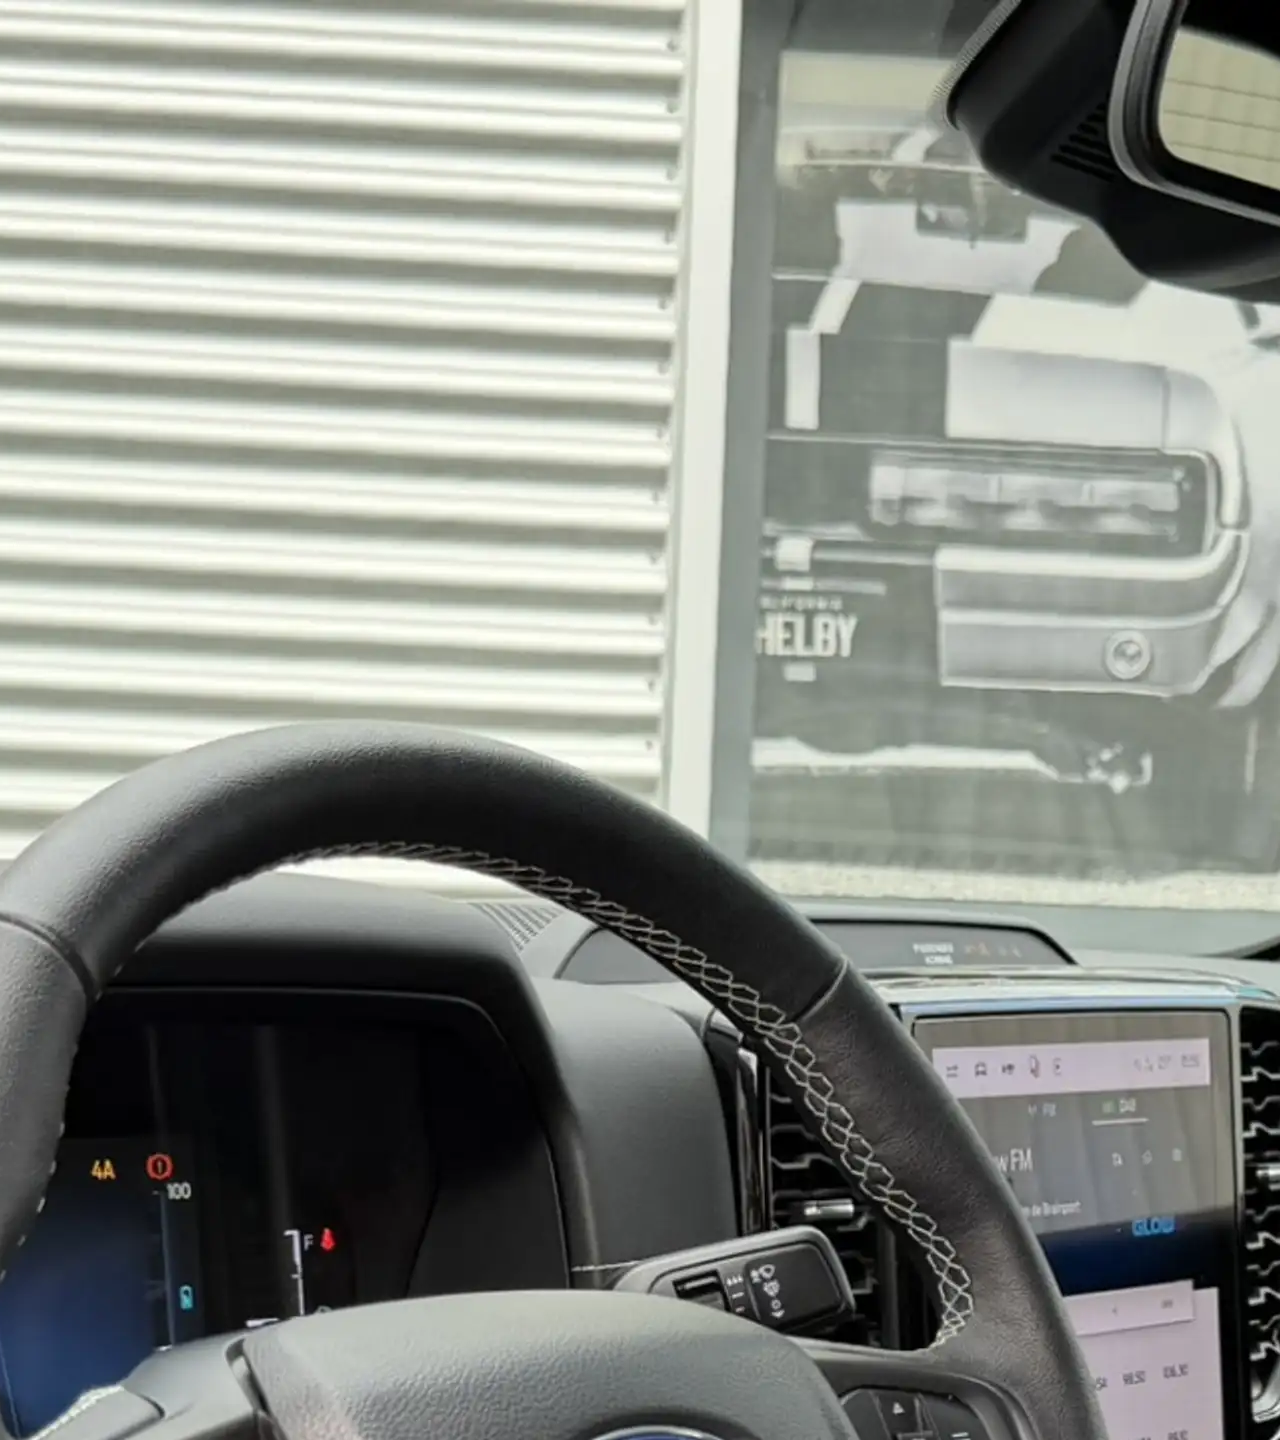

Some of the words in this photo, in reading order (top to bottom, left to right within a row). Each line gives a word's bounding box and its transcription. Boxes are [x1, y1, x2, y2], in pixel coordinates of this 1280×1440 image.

[90, 1159, 117, 1181] 4A
[166, 1182, 192, 1200] 100
[303, 1233, 314, 1250] F
